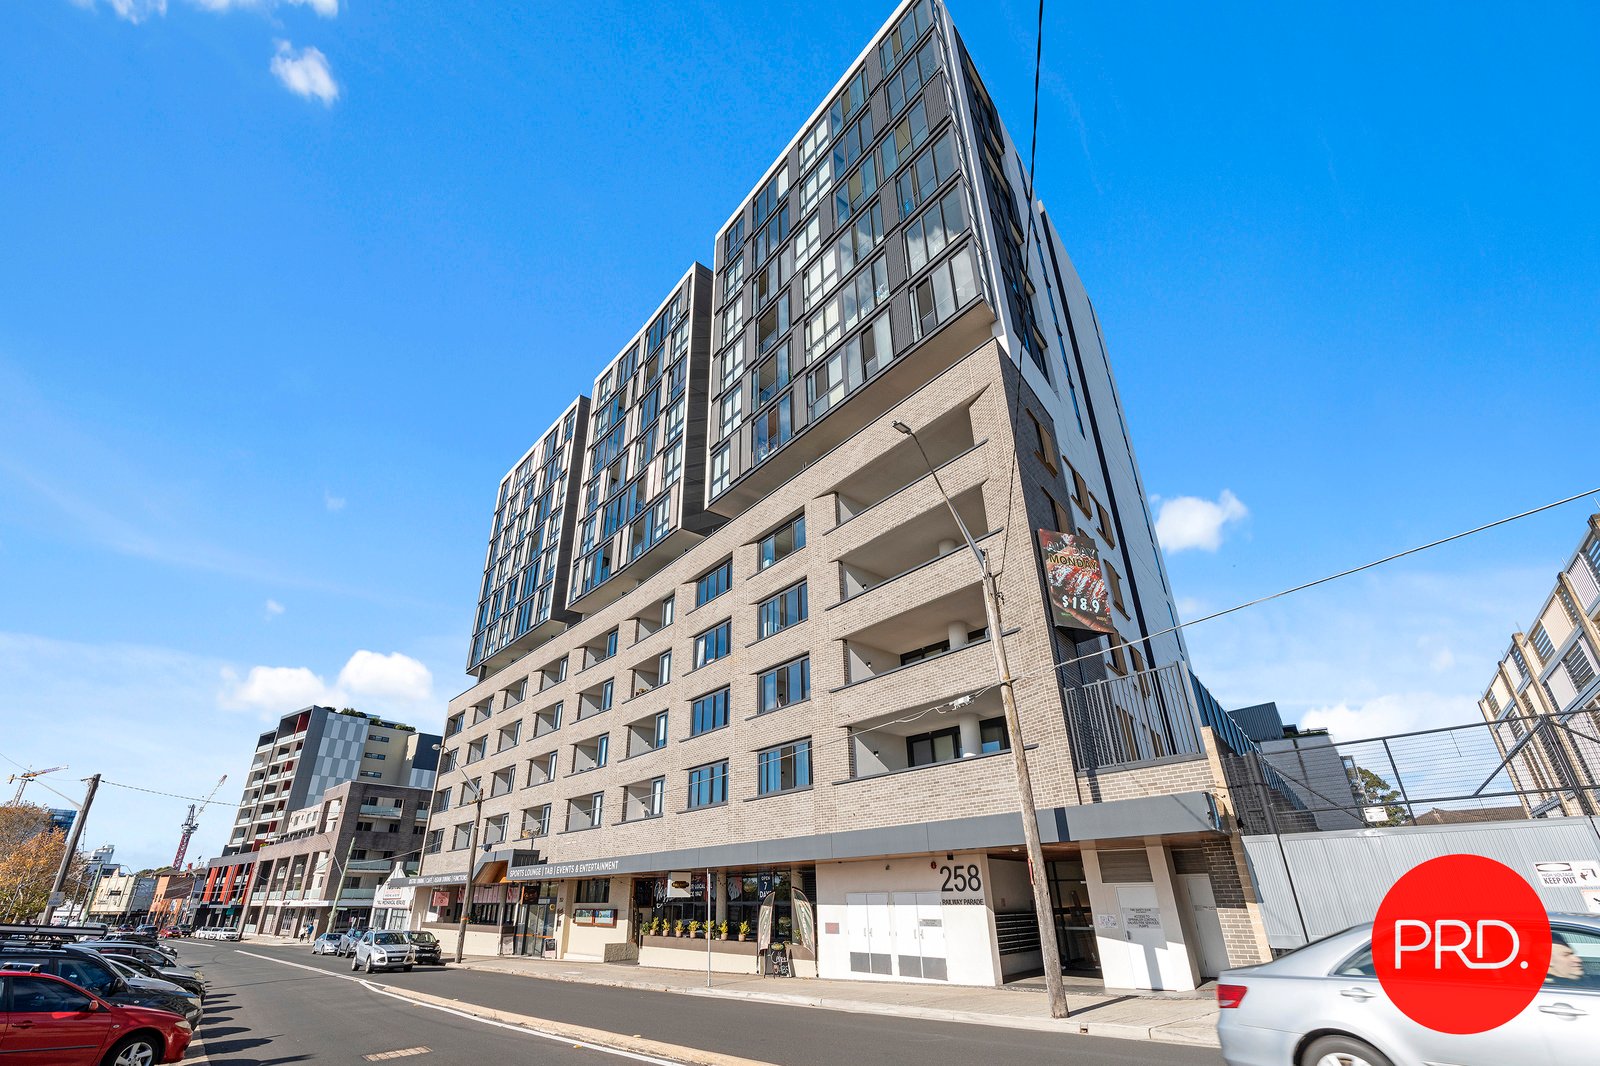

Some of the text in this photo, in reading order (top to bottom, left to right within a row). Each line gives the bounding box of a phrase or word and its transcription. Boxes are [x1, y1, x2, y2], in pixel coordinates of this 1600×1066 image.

[1049, 554, 1097, 569] MONDAY
[509, 860, 619, 878] SPORTS LOUNGE TAB EVENTS & ENTERTAINMENT
[763, 881, 767, 890] 7
[940, 864, 981, 892] 258
[1543, 876, 1577, 885] KEEP OUT
